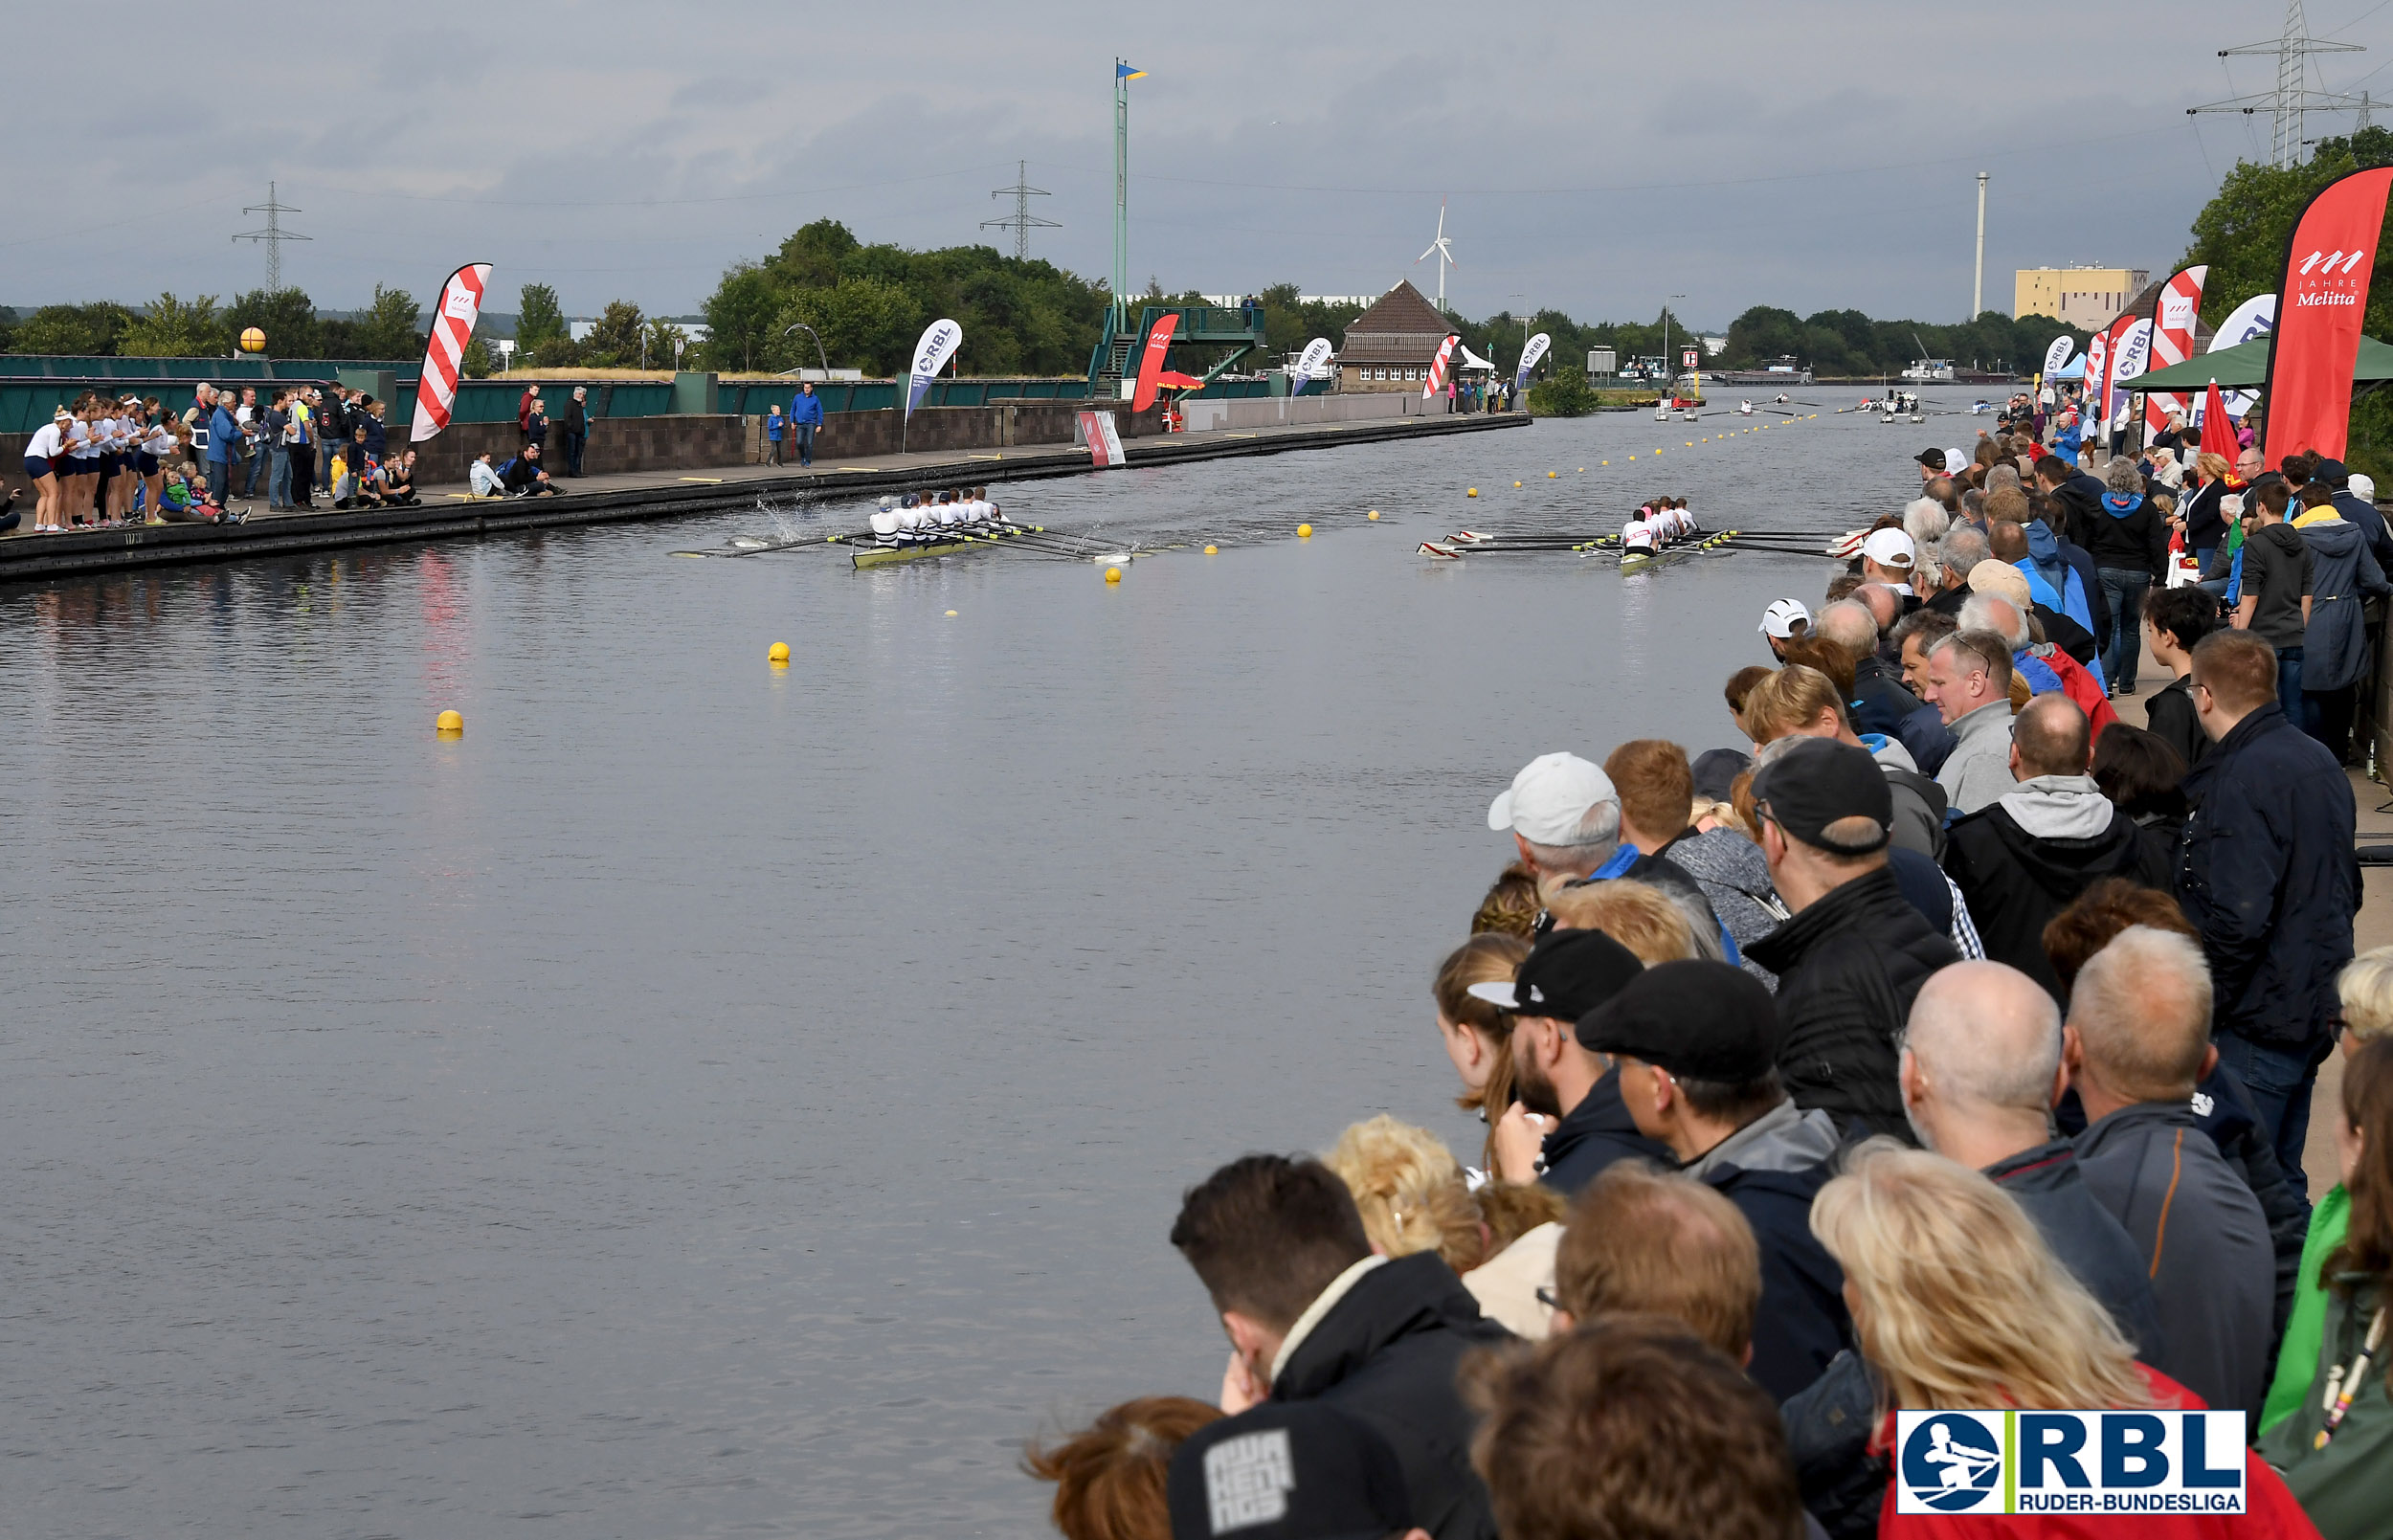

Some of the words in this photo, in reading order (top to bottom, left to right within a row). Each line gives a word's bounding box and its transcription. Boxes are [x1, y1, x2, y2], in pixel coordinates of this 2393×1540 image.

[2299, 279, 2357, 290] JAHRE
[2296, 291, 2356, 306] Melitta
[926, 328, 951, 358] RBL
[1529, 338, 1546, 356] RBL
[2051, 341, 2069, 361] RBL
[2126, 327, 2153, 361] RBL
[1308, 344, 1326, 363] RBL
